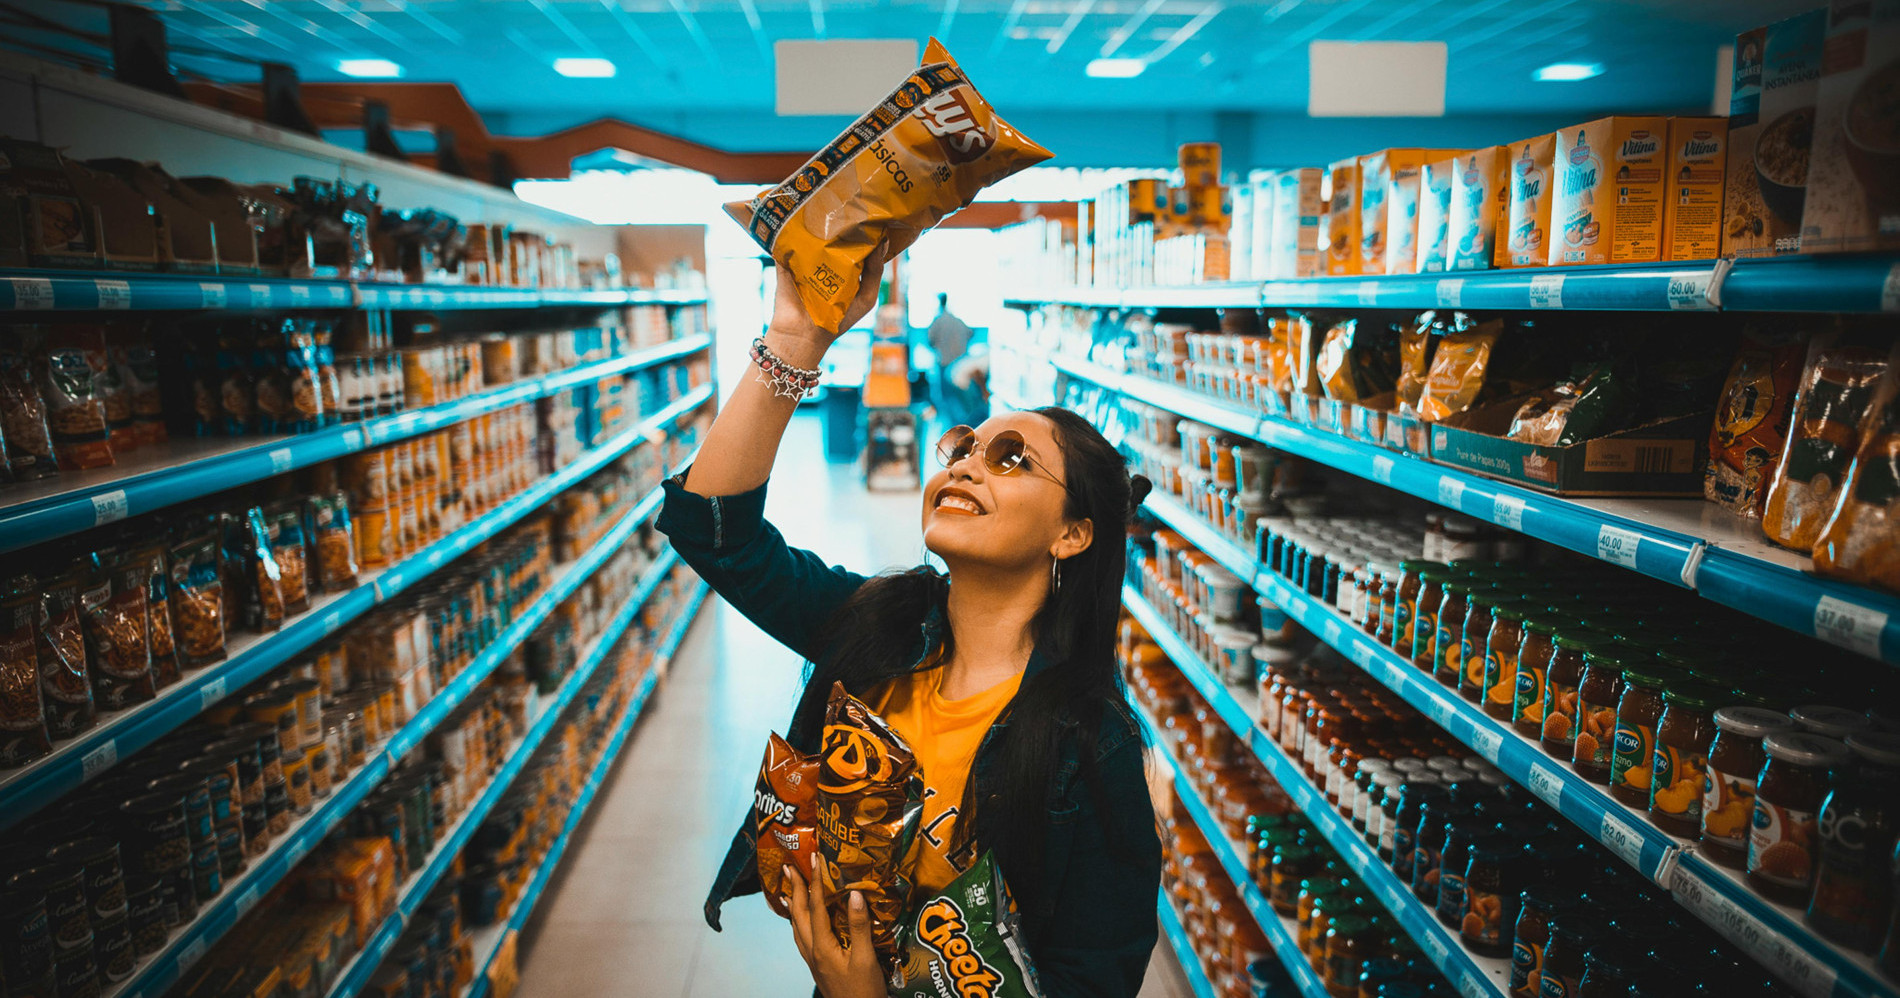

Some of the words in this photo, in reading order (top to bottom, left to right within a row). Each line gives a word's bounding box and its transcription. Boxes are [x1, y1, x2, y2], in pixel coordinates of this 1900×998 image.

[1622, 140, 1656, 157] Vitina
[1684, 140, 1718, 157] Vitina
[813, 265, 841, 296] 105g
[1600, 534, 1622, 551] 40.00
[1603, 823, 1627, 847] 62.00
